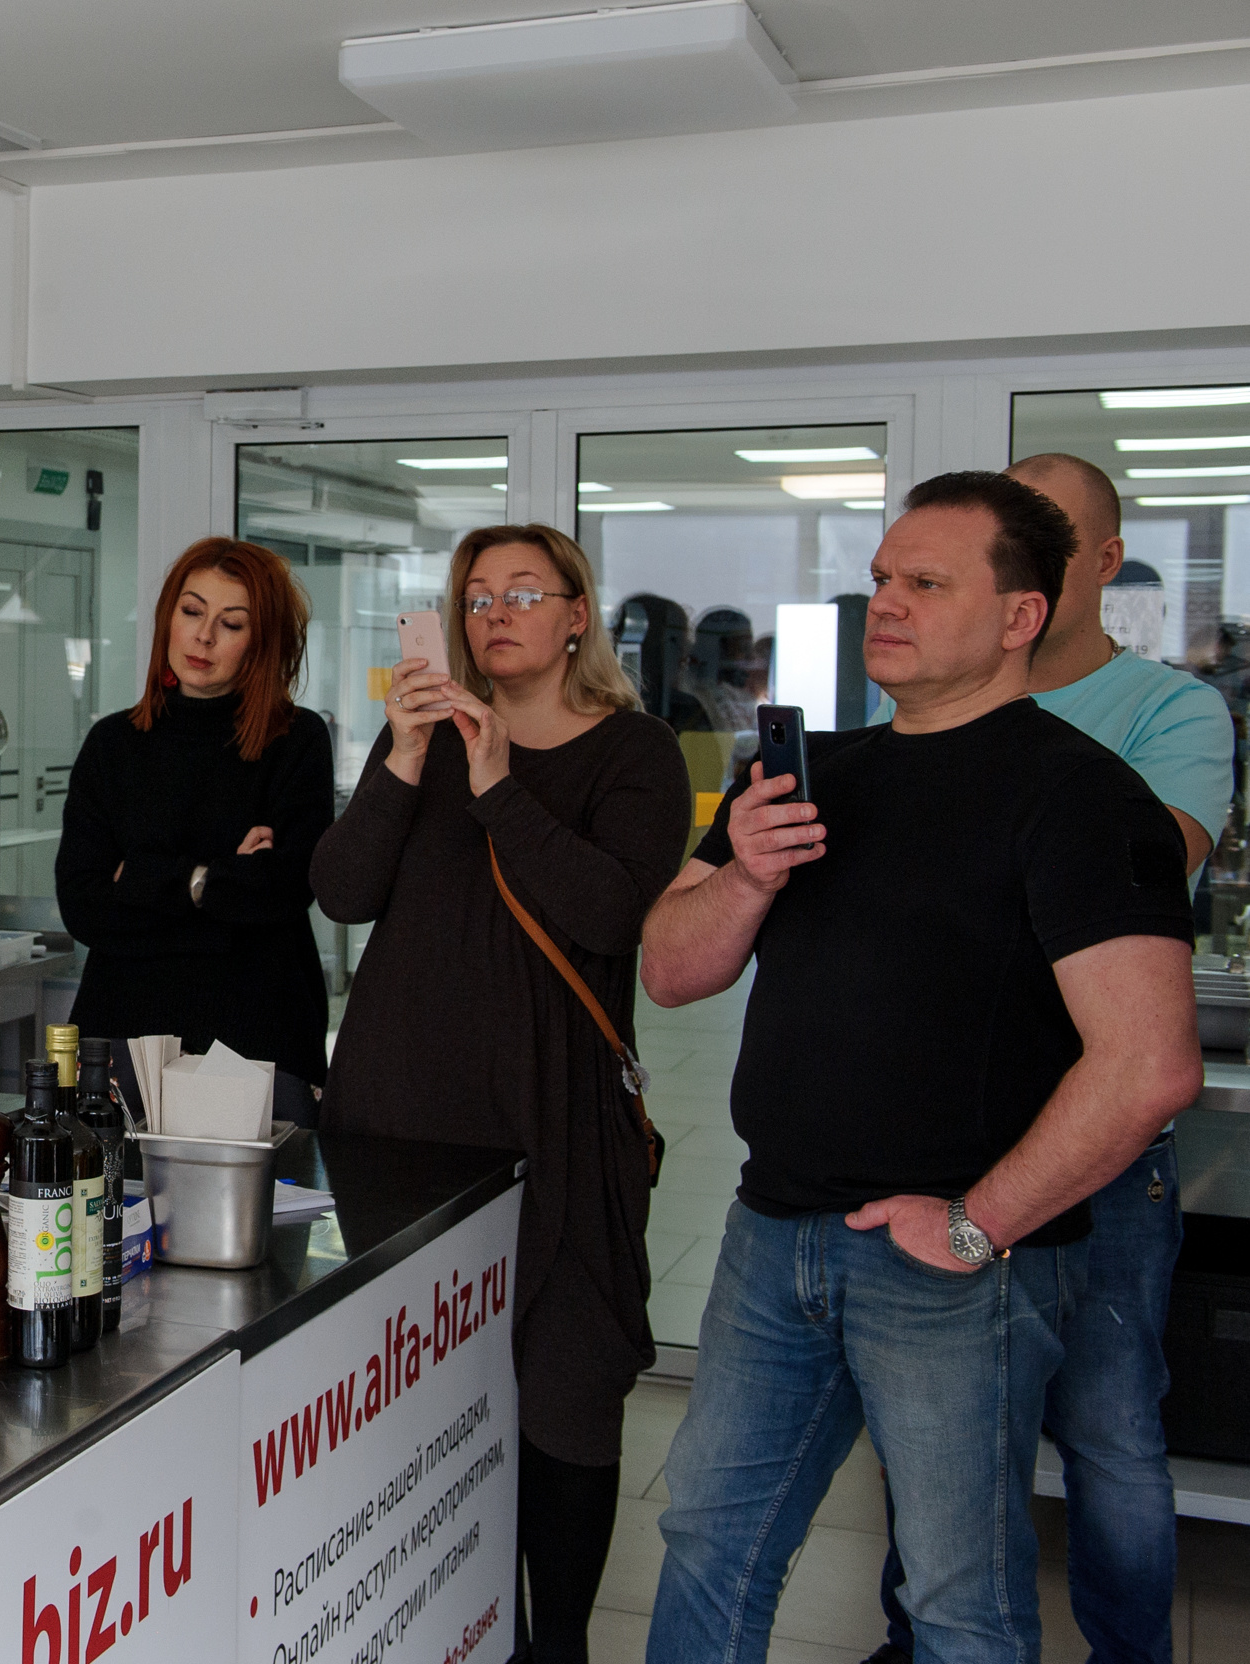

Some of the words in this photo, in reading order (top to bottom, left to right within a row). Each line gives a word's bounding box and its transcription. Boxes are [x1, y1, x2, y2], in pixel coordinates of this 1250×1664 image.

[41, 1204, 50, 1245] ORGANIC
[252, 1256, 507, 1508] www.alfa-biz.ru
[272, 1600, 341, 1664] Онлайн
[344, 1545, 397, 1633] доступ
[401, 1533, 408, 1567] к
[410, 1438, 505, 1555] мероприятиям,
[273, 1500, 374, 1617] Расписание
[378, 1443, 423, 1522] нашей
[425, 1392, 490, 1475] площадки,
[430, 1521, 480, 1600] питания
